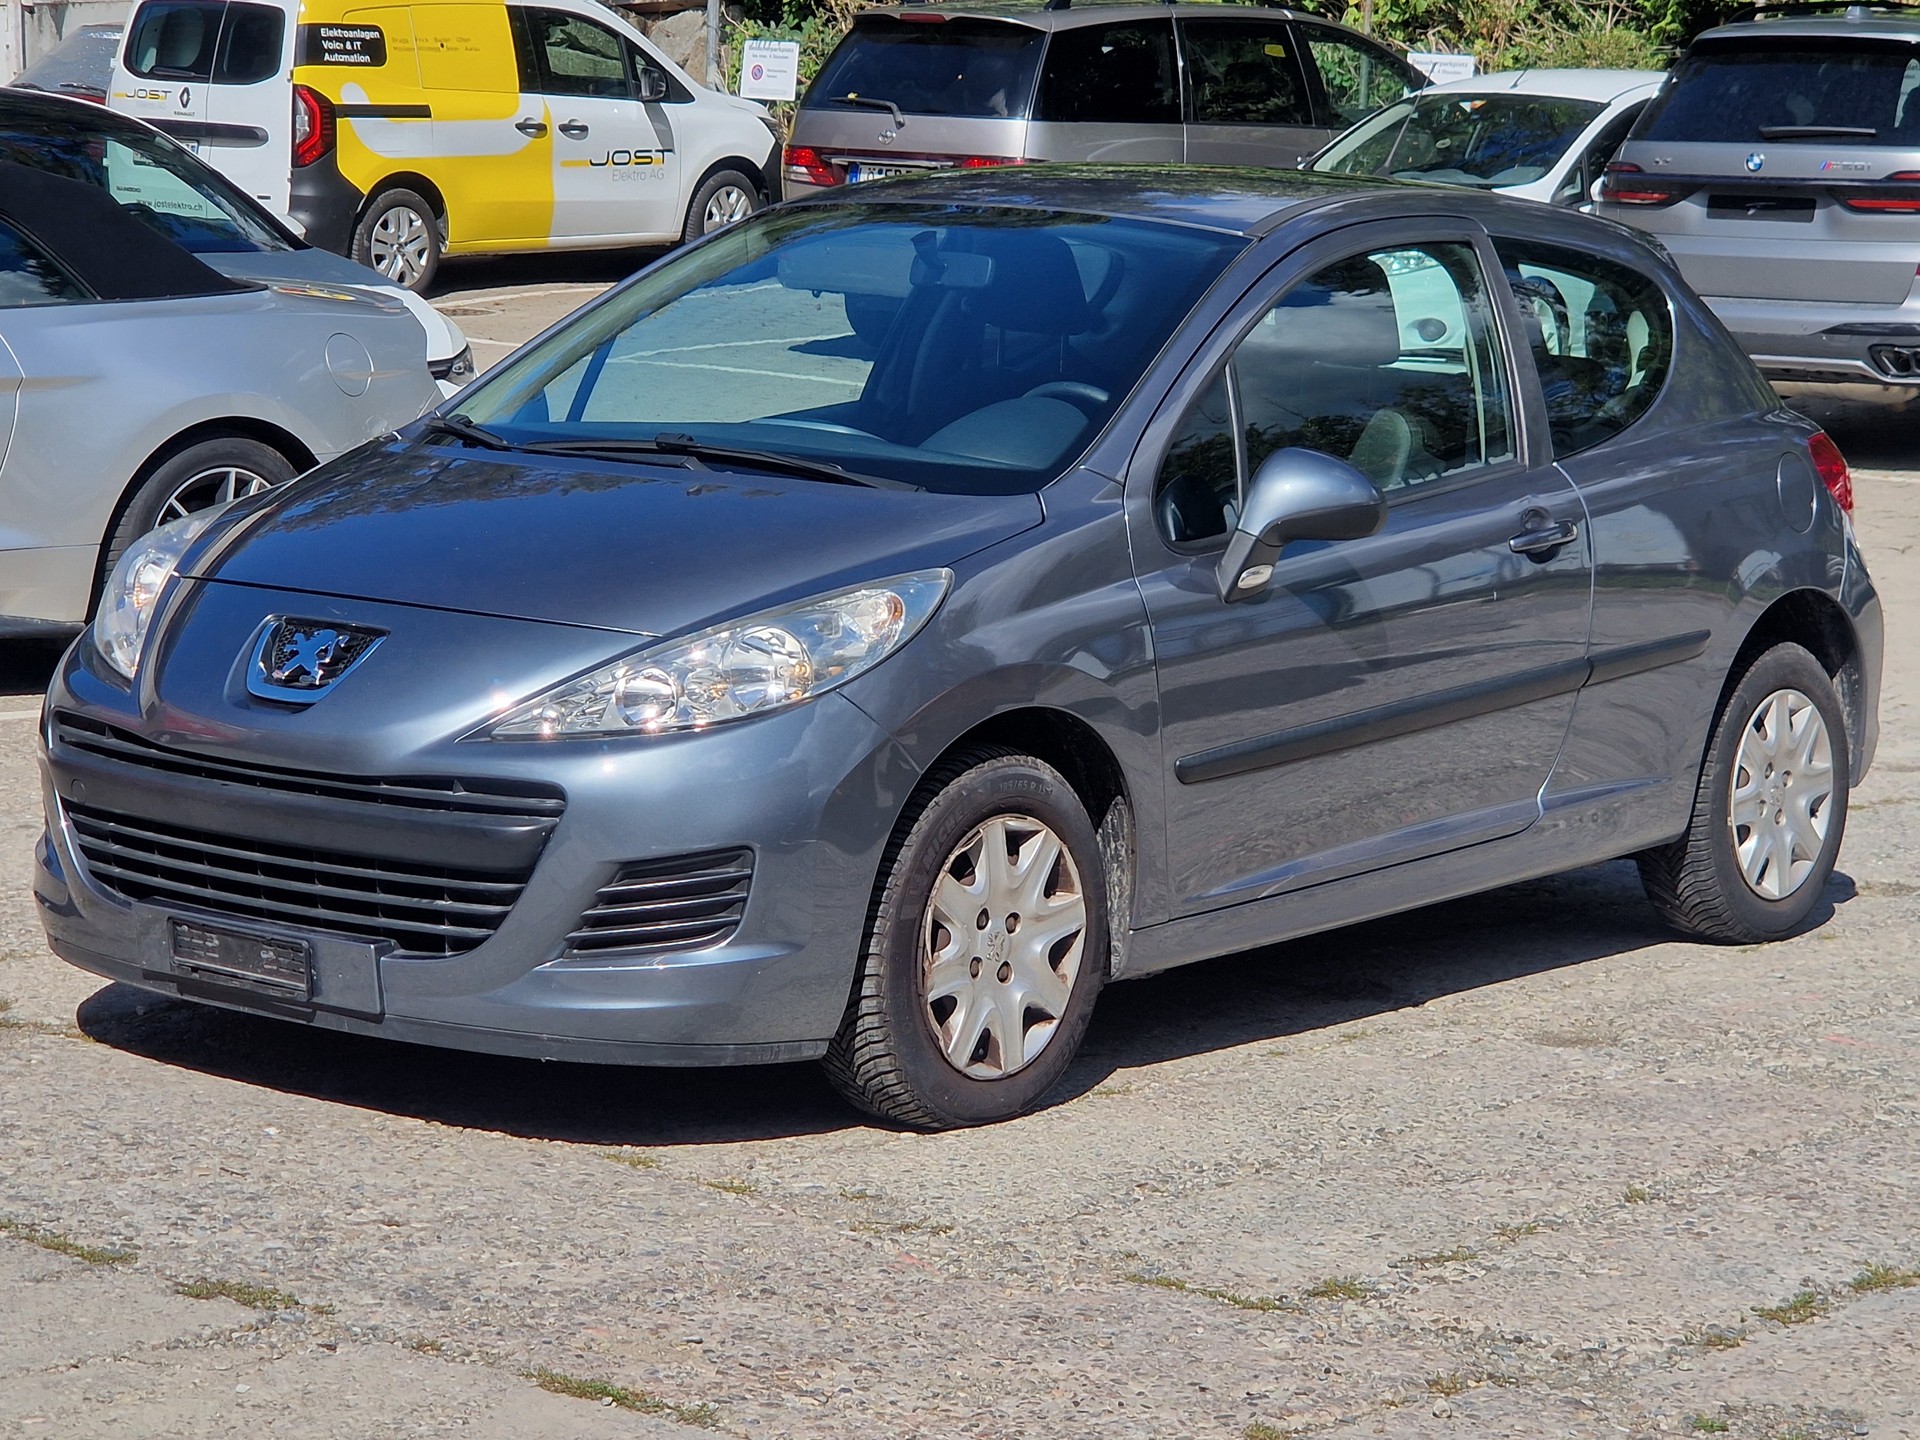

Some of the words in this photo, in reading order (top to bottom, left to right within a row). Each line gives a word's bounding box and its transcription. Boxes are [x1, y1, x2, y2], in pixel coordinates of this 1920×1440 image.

[320, 27, 380, 40] Elektroanlagen
[345, 41, 352, 50] &
[353, 41, 362, 50] IT
[323, 52, 371, 63] Automation
[125, 88, 172, 100] JOST
[589, 149, 674, 166] JOST
[612, 169, 647, 181] Elektro
[650, 168, 665, 180] AG
